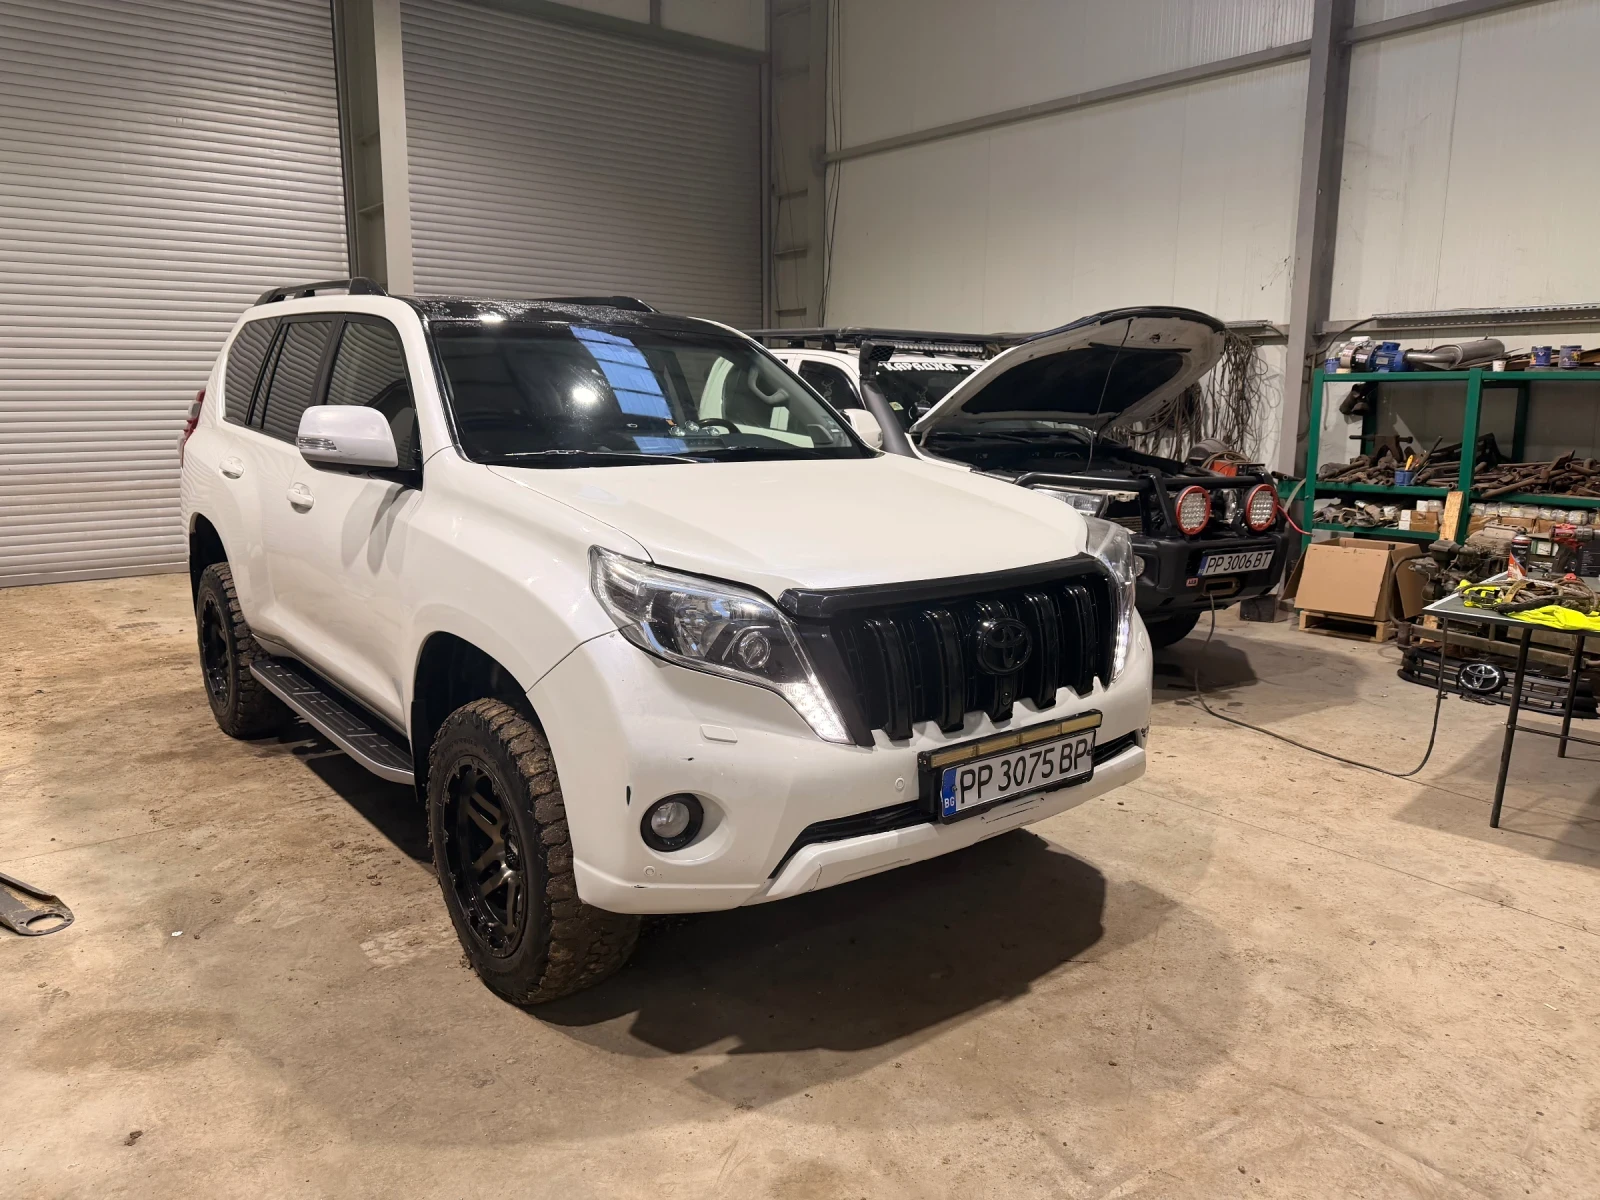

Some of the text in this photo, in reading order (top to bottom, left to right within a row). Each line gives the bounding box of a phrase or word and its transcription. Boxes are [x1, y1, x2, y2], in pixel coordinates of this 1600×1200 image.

[1206, 557, 1225, 573] PP
[1224, 554, 1253, 571] 3006
[1253, 552, 1272, 568] BT
[959, 738, 1088, 804] PP 3075 BP
[944, 796, 955, 809] BG
